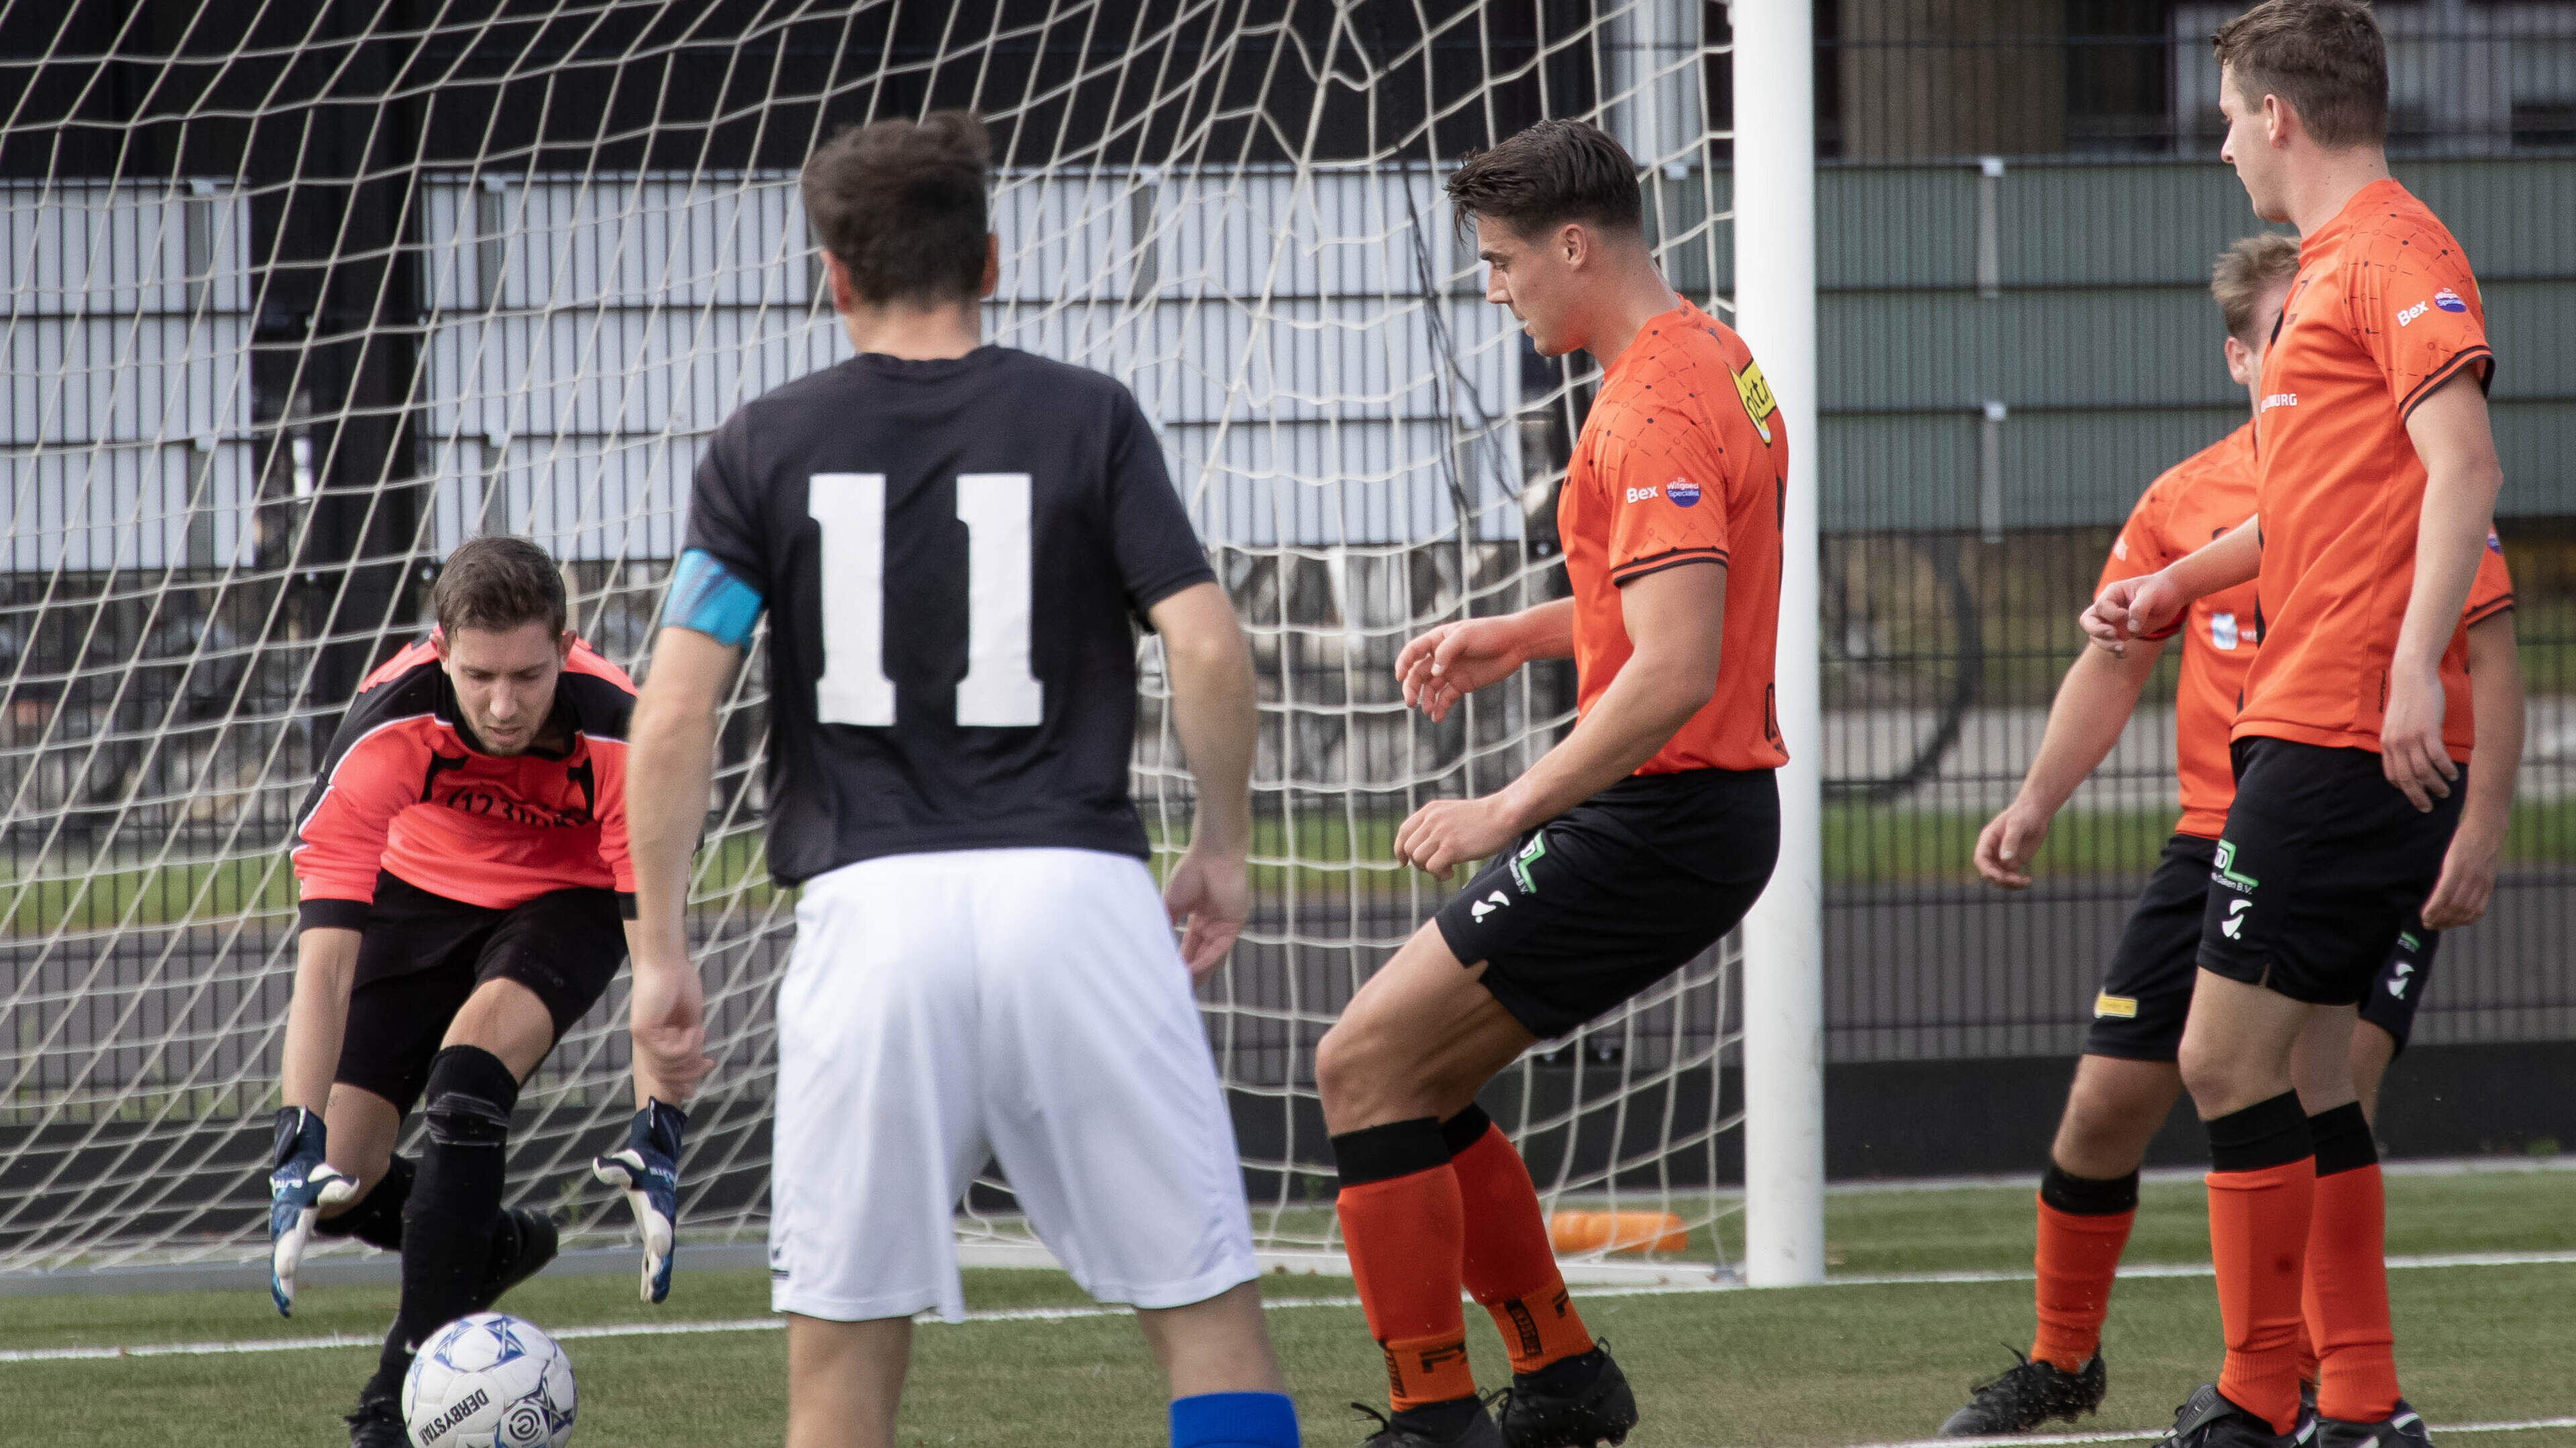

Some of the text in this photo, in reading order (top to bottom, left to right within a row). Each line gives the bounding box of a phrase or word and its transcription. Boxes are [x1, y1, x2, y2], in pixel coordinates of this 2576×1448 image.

[2397, 300, 2429, 327] Bex
[1626, 486, 1659, 504] Bex
[808, 473, 1044, 727] 11
[418, 1388, 490, 1447] DERBYSTAR
